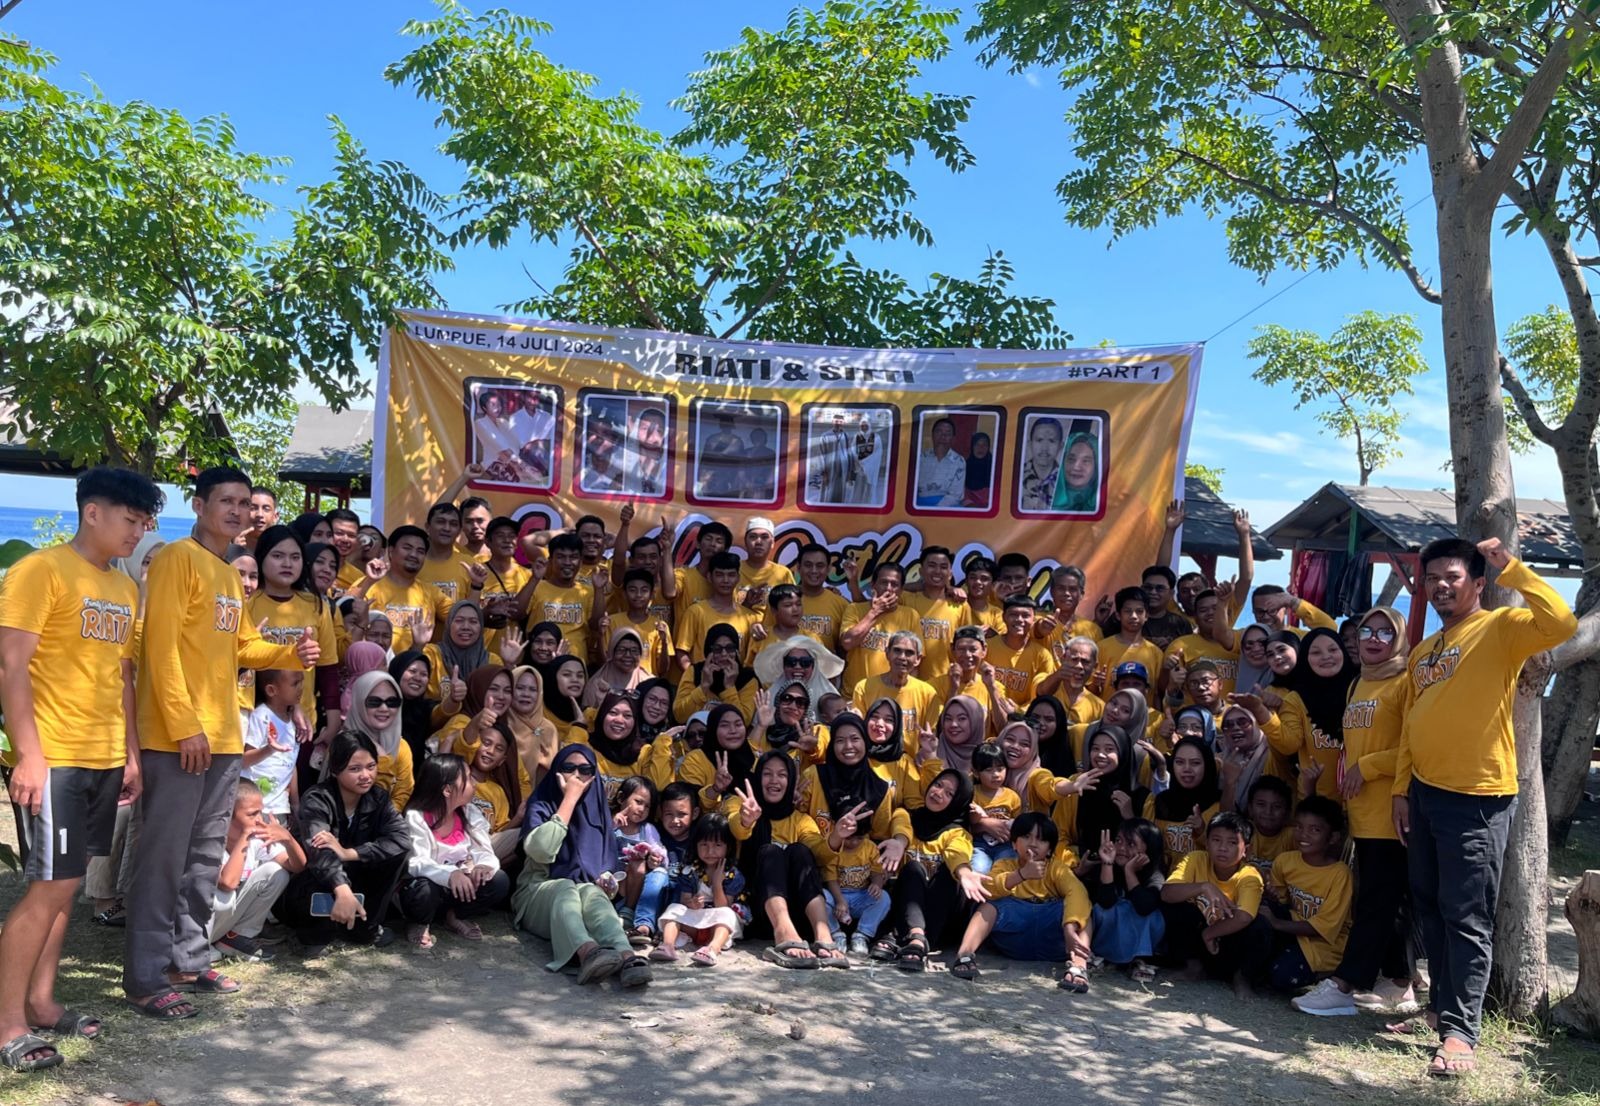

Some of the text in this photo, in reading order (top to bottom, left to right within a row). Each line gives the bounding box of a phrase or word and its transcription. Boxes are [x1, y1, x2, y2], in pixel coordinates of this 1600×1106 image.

[414, 326, 604, 355] LUMPUE, 14 JULI 2024
[675, 352, 915, 383] RIATI & SITTI
[1067, 365, 1160, 380] #PART 1
[80, 608, 132, 645] RIATI
[59, 827, 68, 855] 1
